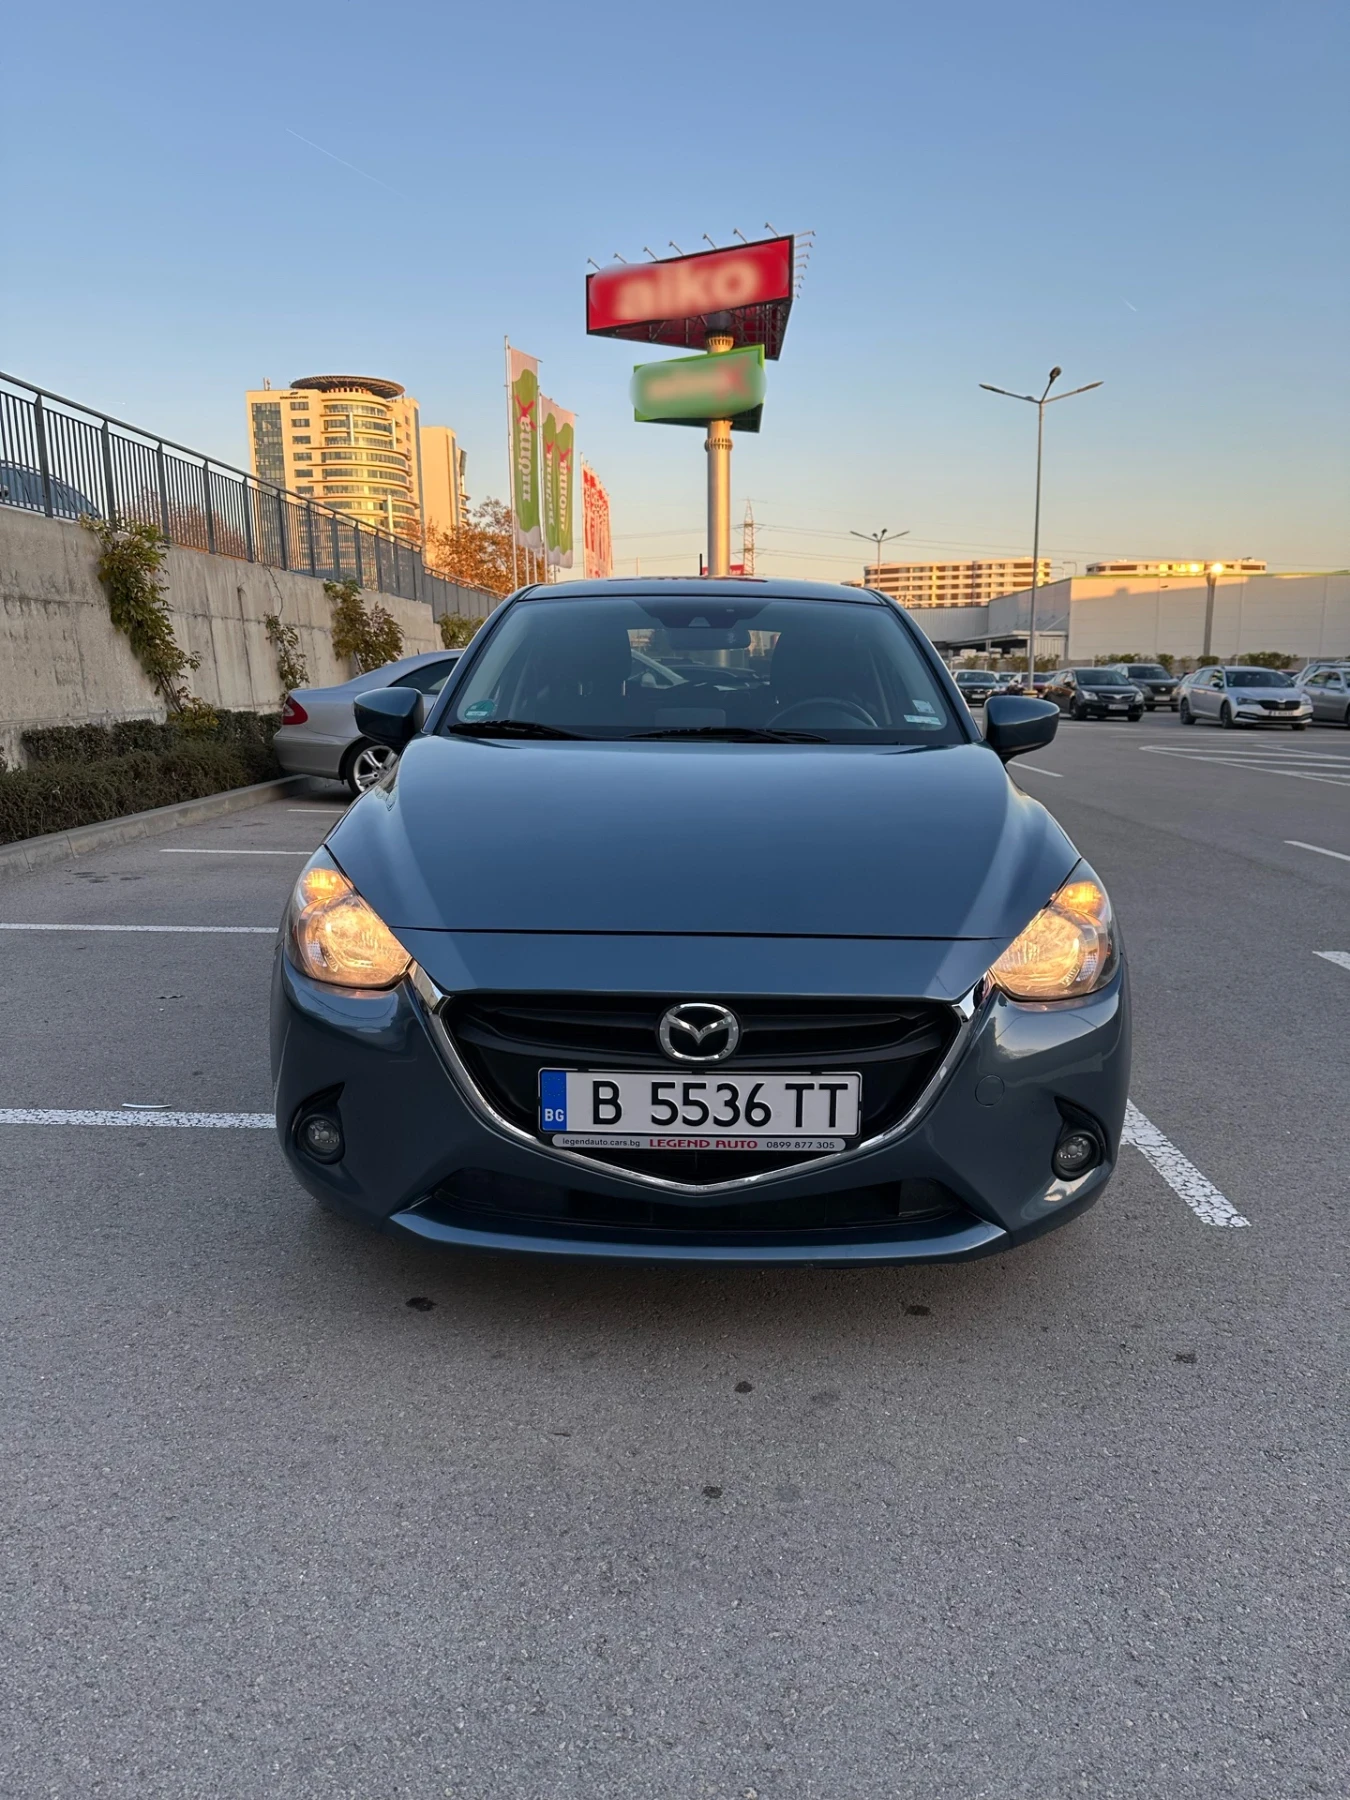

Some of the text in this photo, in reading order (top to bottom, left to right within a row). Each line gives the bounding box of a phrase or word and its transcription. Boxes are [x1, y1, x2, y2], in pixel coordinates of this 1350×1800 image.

[593, 1080, 848, 1128] B 5536 TT
[544, 1108, 564, 1121] BG
[562, 1138, 835, 1149] legendauto.cars.bg LEGEND AUTO 0899 877 305
